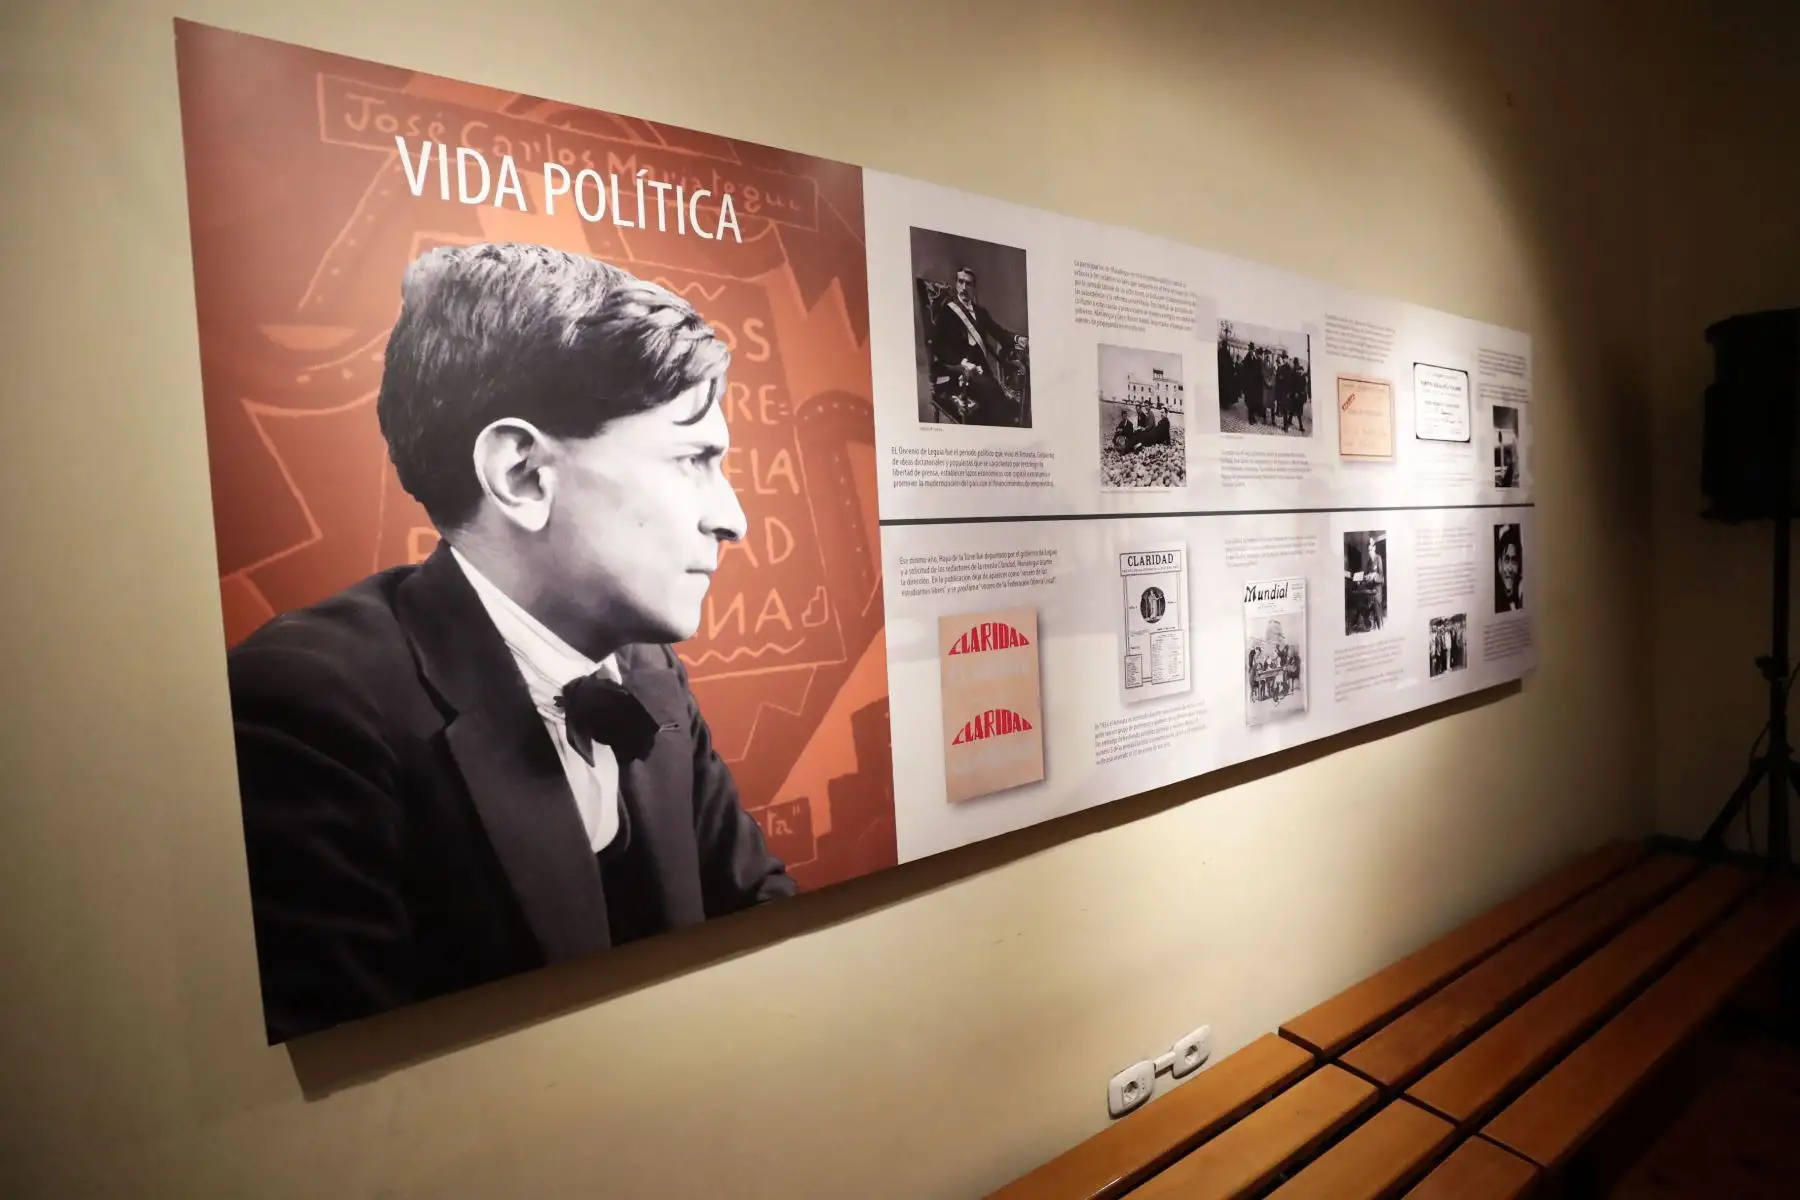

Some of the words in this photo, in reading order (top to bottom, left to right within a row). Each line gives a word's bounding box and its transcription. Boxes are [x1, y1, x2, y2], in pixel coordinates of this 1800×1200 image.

[460, 120, 595, 170] Carlos
[395, 135, 528, 212] VIDA
[544, 162, 743, 244] POLÍTICA
[945, 448, 953, 456] fue
[893, 458, 899, 466] de
[900, 458, 914, 466] ideas
[915, 458, 945, 467] dictatoriales
[892, 468, 913, 477] libertad
[914, 469, 921, 477] de
[922, 470, 939, 478] prensa,
[893, 480, 917, 489] promover
[900, 556, 909, 565] Ese
[952, 553, 958, 561] de
[1127, 553, 1174, 567] CLARIDAD
[931, 565, 937, 573] de
[946, 564, 970, 572] redactores
[971, 563, 977, 571] de
[932, 575, 938, 584] En
[1243, 581, 1289, 603] Mundial
[948, 622, 1030, 655] CLARIDAD
[952, 708, 1033, 745] CLARIDAD
